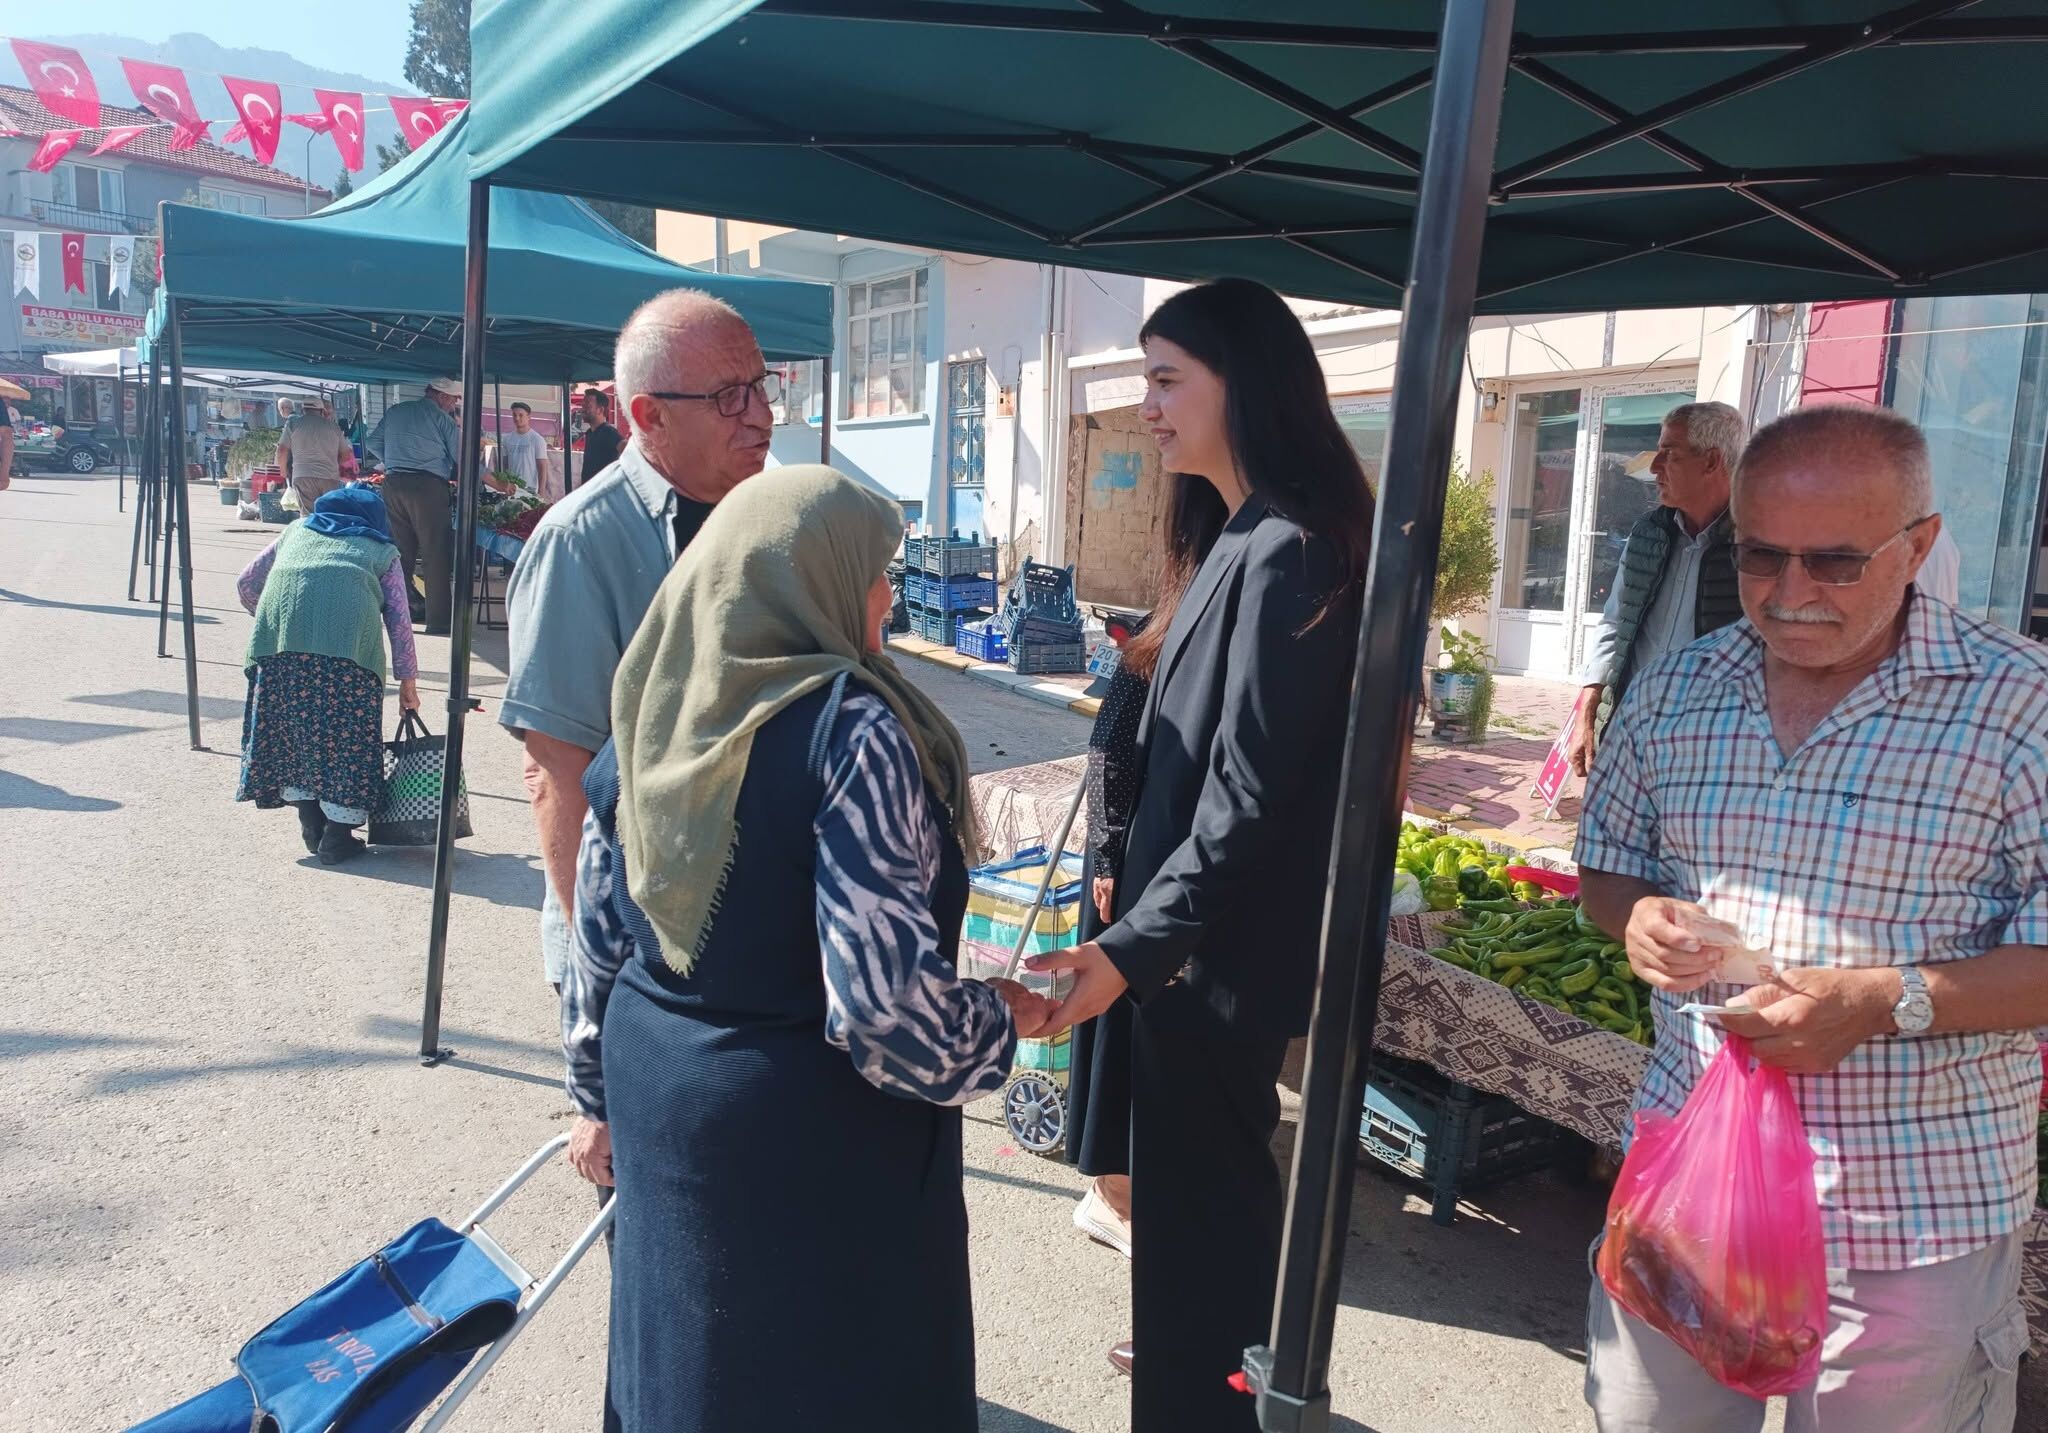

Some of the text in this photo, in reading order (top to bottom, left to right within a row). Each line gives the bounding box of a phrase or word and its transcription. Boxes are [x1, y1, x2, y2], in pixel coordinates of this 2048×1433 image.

[31, 308, 65, 320] BABA
[67, 312, 102, 324] UNLU
[1097, 648, 1113, 661] 20
[1100, 662, 1116, 675] 93
